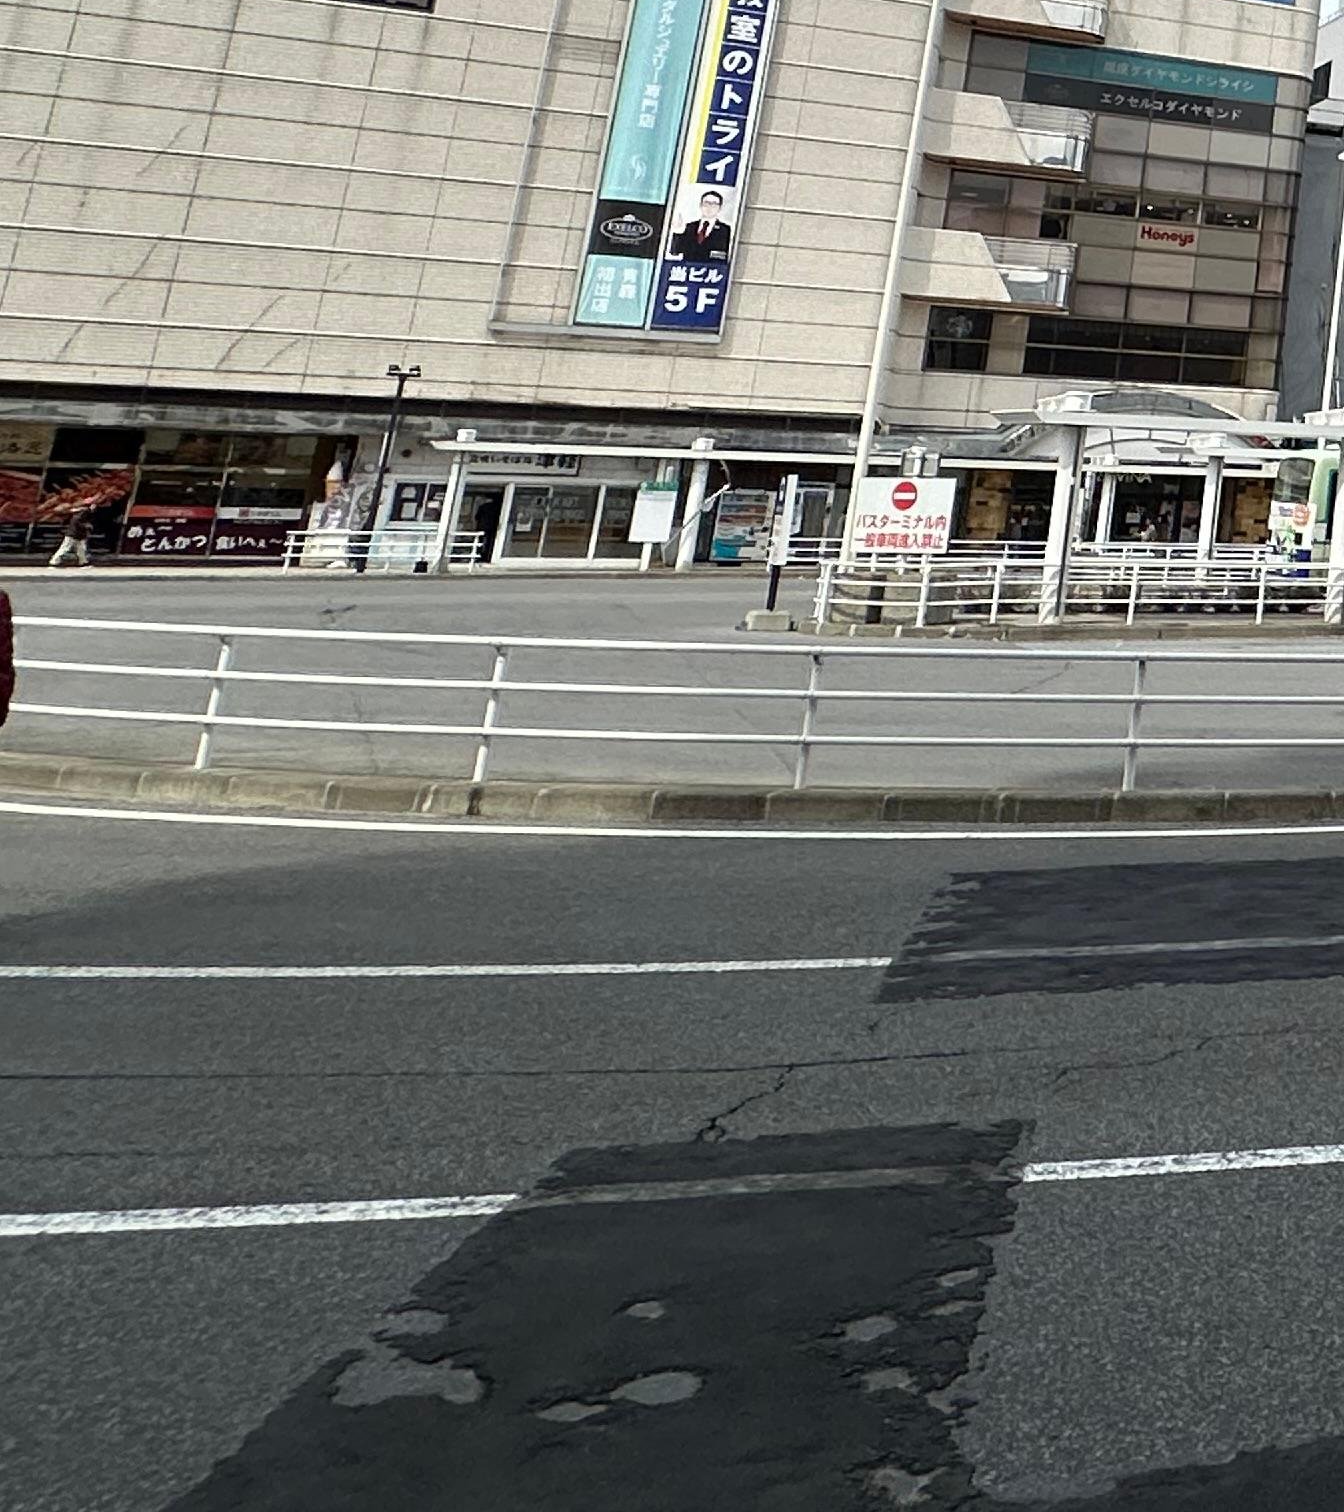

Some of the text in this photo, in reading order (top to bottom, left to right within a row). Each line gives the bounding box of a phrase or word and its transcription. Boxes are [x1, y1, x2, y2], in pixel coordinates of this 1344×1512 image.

[1100, 92, 1243, 121] エクセルコダイヤモンド
[1140, 225, 1195, 247] Honeys
[668, 266, 723, 284] 当ビル
[664, 286, 720, 313] 5F
[856, 514, 947, 530] バスターミナル内
[140, 535, 208, 552] とんかつ
